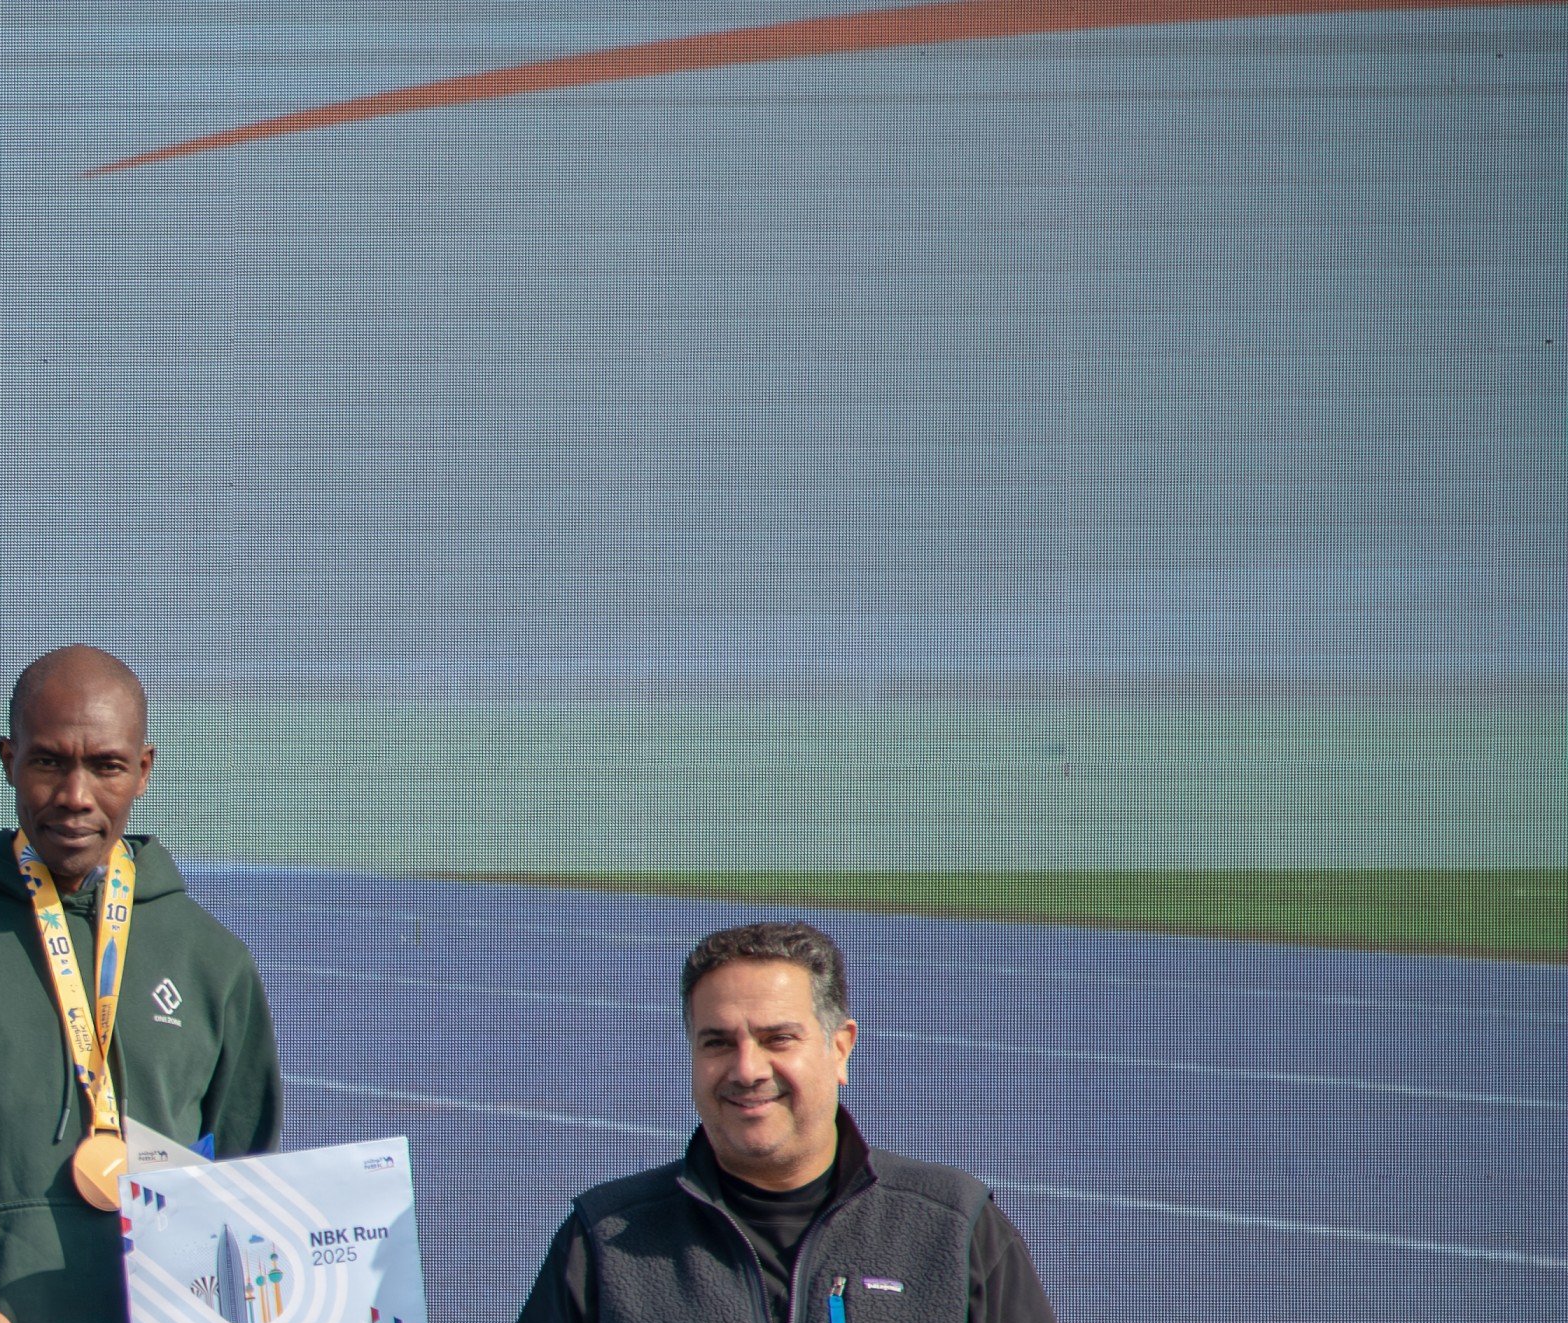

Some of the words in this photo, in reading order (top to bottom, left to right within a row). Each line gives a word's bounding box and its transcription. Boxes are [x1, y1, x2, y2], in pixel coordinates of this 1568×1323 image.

[105, 905, 127, 923] 10
[49, 937, 71, 955] 10
[309, 1228, 348, 1247] NBK
[353, 1224, 389, 1242] Run
[312, 1246, 357, 1266] 2025
